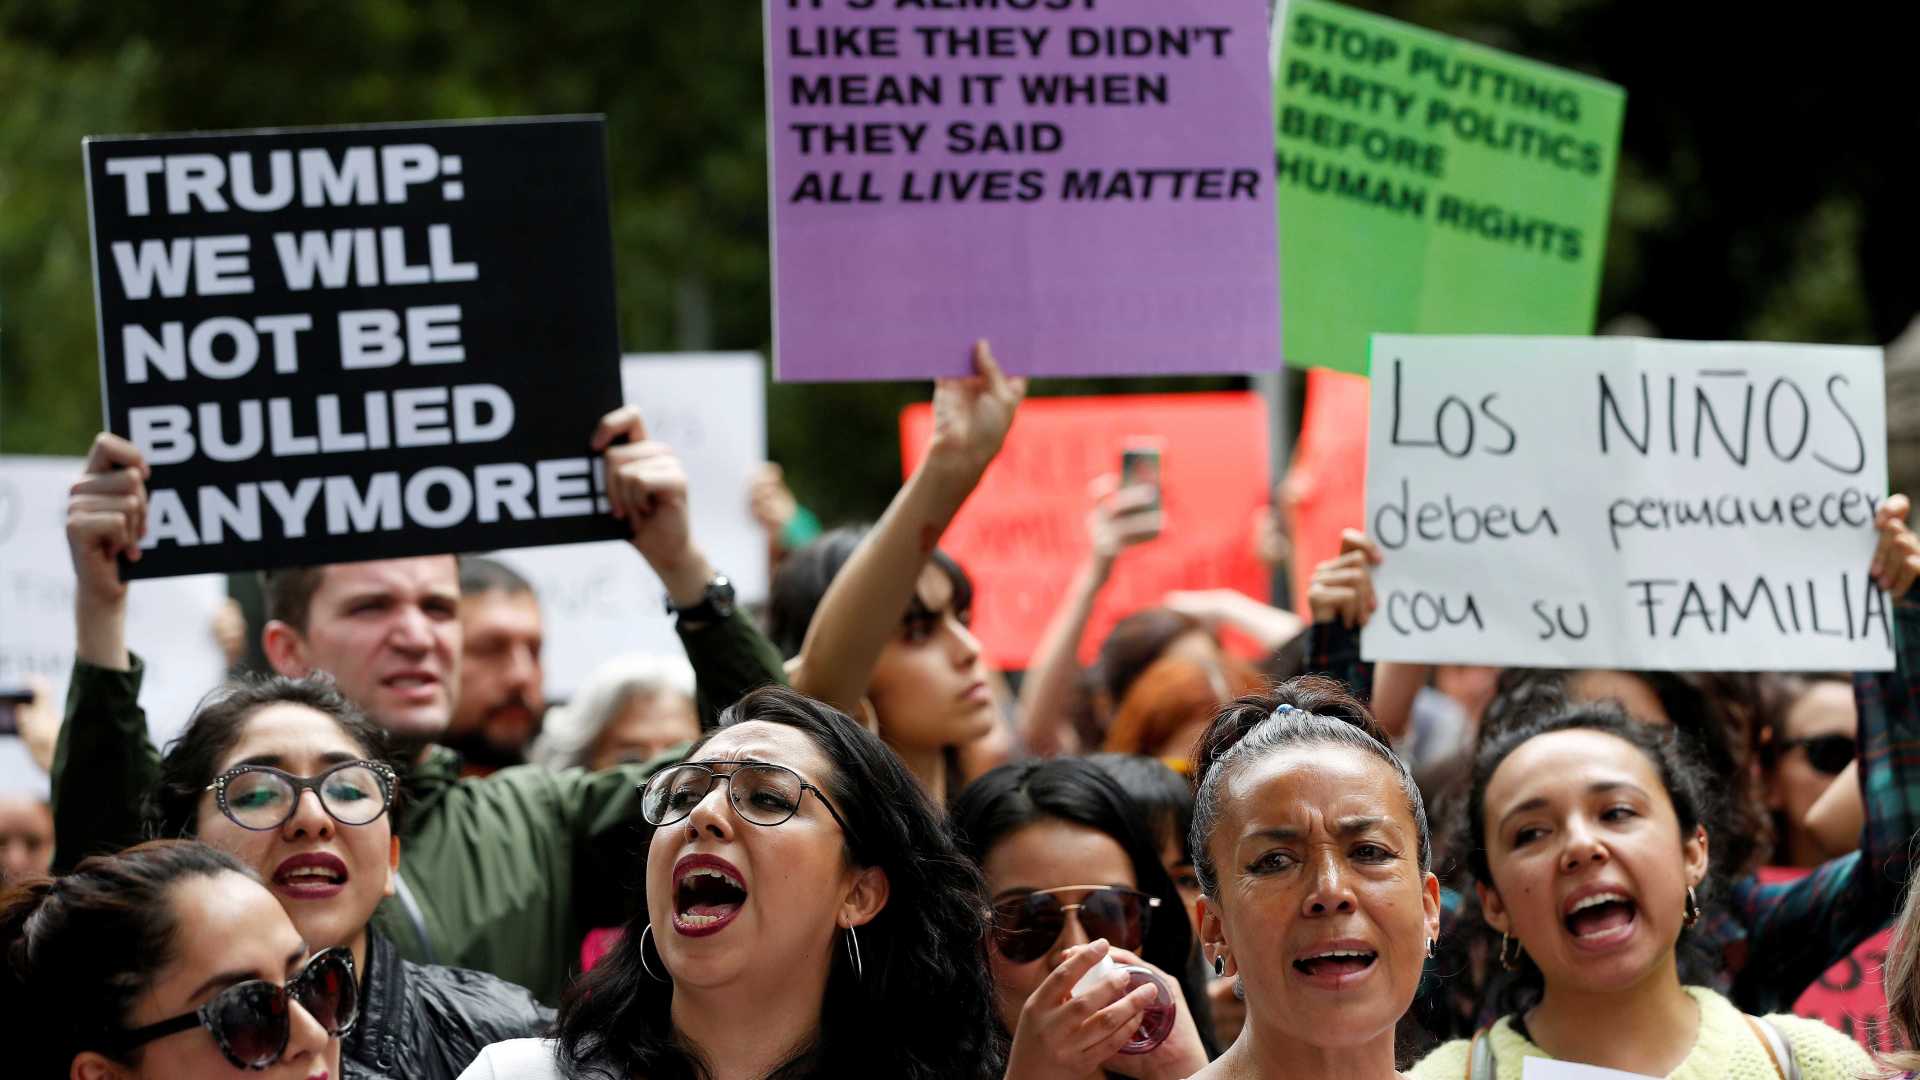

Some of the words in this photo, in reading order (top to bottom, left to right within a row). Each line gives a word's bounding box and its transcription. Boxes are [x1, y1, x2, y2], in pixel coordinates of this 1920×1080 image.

[788, 26, 899, 58] LIKE
[914, 26, 1051, 58] THEY
[1069, 26, 1232, 58] DIDN'T
[1293, 14, 1398, 64] STOP
[1409, 47, 1581, 124] PUTTING
[789, 75, 942, 106] MEAN
[960, 74, 1003, 106] IT
[1019, 74, 1169, 105] WHEN
[1287, 59, 1418, 121] PARTY
[1424, 97, 1603, 177] POLITICS
[790, 123, 929, 155] THEY
[945, 122, 1065, 154] SAID
[1279, 105, 1447, 177] BEFORE
[106, 144, 463, 216] TRUMP:
[789, 171, 882, 203] ALL
[900, 170, 1044, 202] LIVES
[1060, 168, 1261, 201] MATTER
[1274, 151, 1428, 219] HUMAN
[1437, 194, 1584, 263] RIGHTS
[112, 234, 255, 300] WE
[273, 224, 478, 291] WILL
[122, 313, 312, 384] NOT
[337, 304, 466, 370] BE
[128, 383, 515, 466] BULLIED
[1598, 369, 1866, 474] NIÑOS
[1627, 573, 1893, 648] FAMILIA
